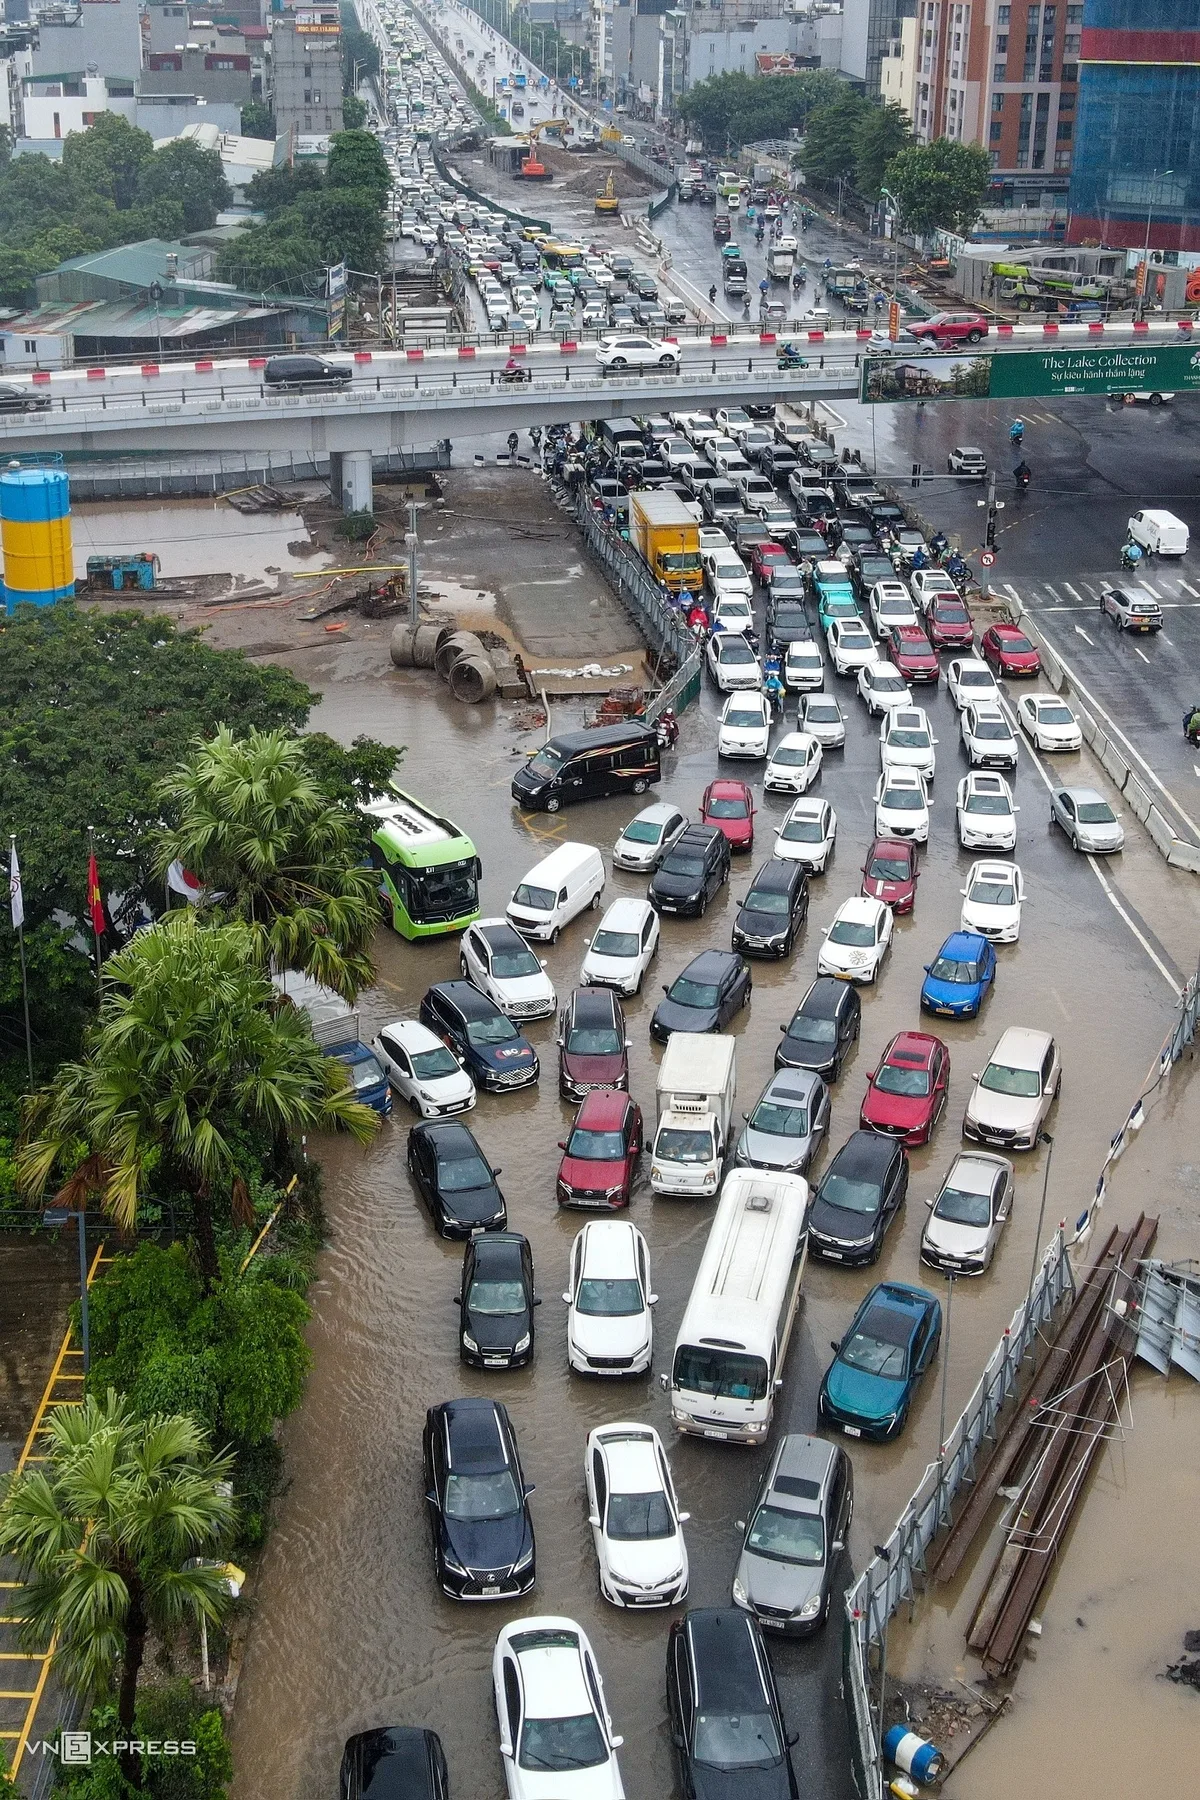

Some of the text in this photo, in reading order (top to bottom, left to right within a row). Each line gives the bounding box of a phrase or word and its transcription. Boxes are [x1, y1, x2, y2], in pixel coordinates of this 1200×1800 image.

[1042, 353, 1157, 369] The Lake Collection
